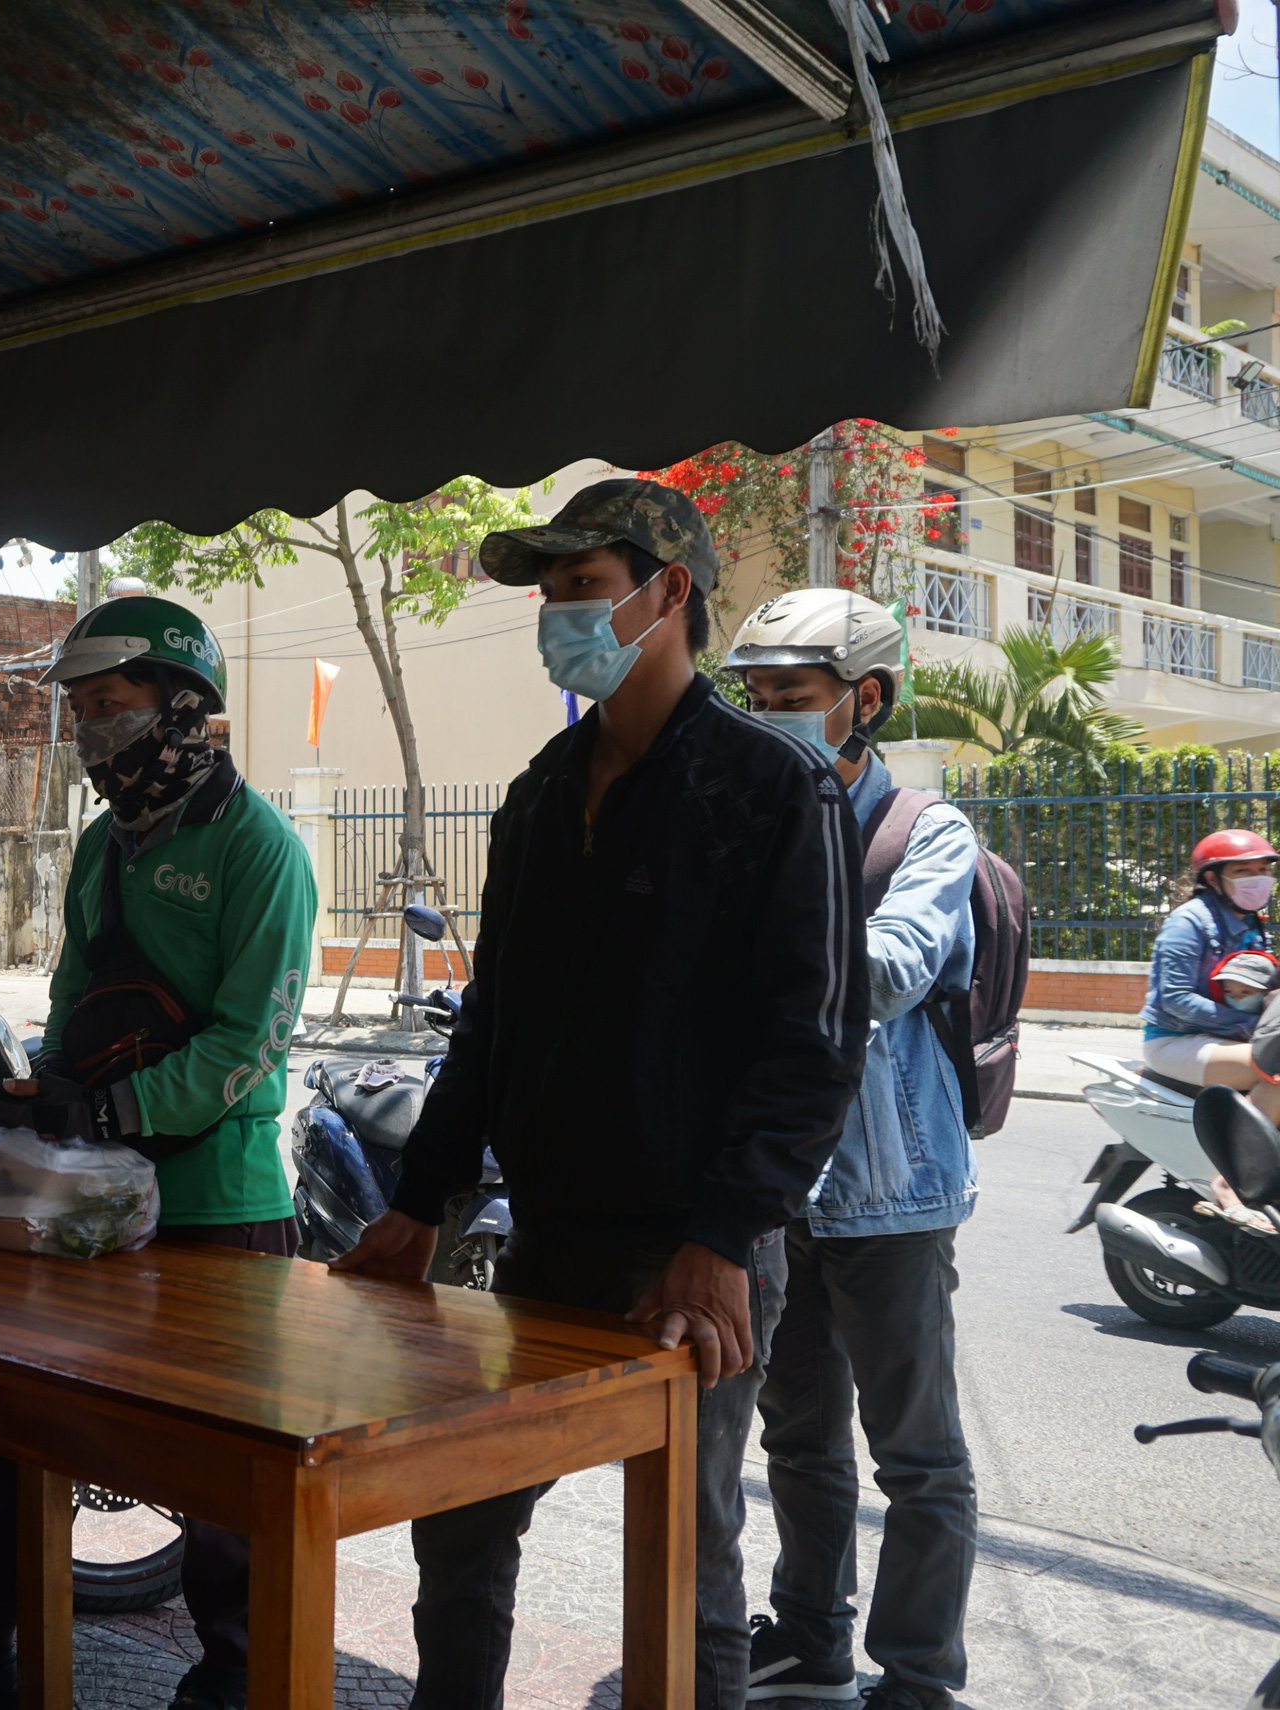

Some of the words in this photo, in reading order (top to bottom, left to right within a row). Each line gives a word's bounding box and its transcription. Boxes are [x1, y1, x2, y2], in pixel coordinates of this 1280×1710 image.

[163, 627, 218, 667] Grab
[154, 863, 211, 901] Grab
[223, 968, 303, 1107] Grab
